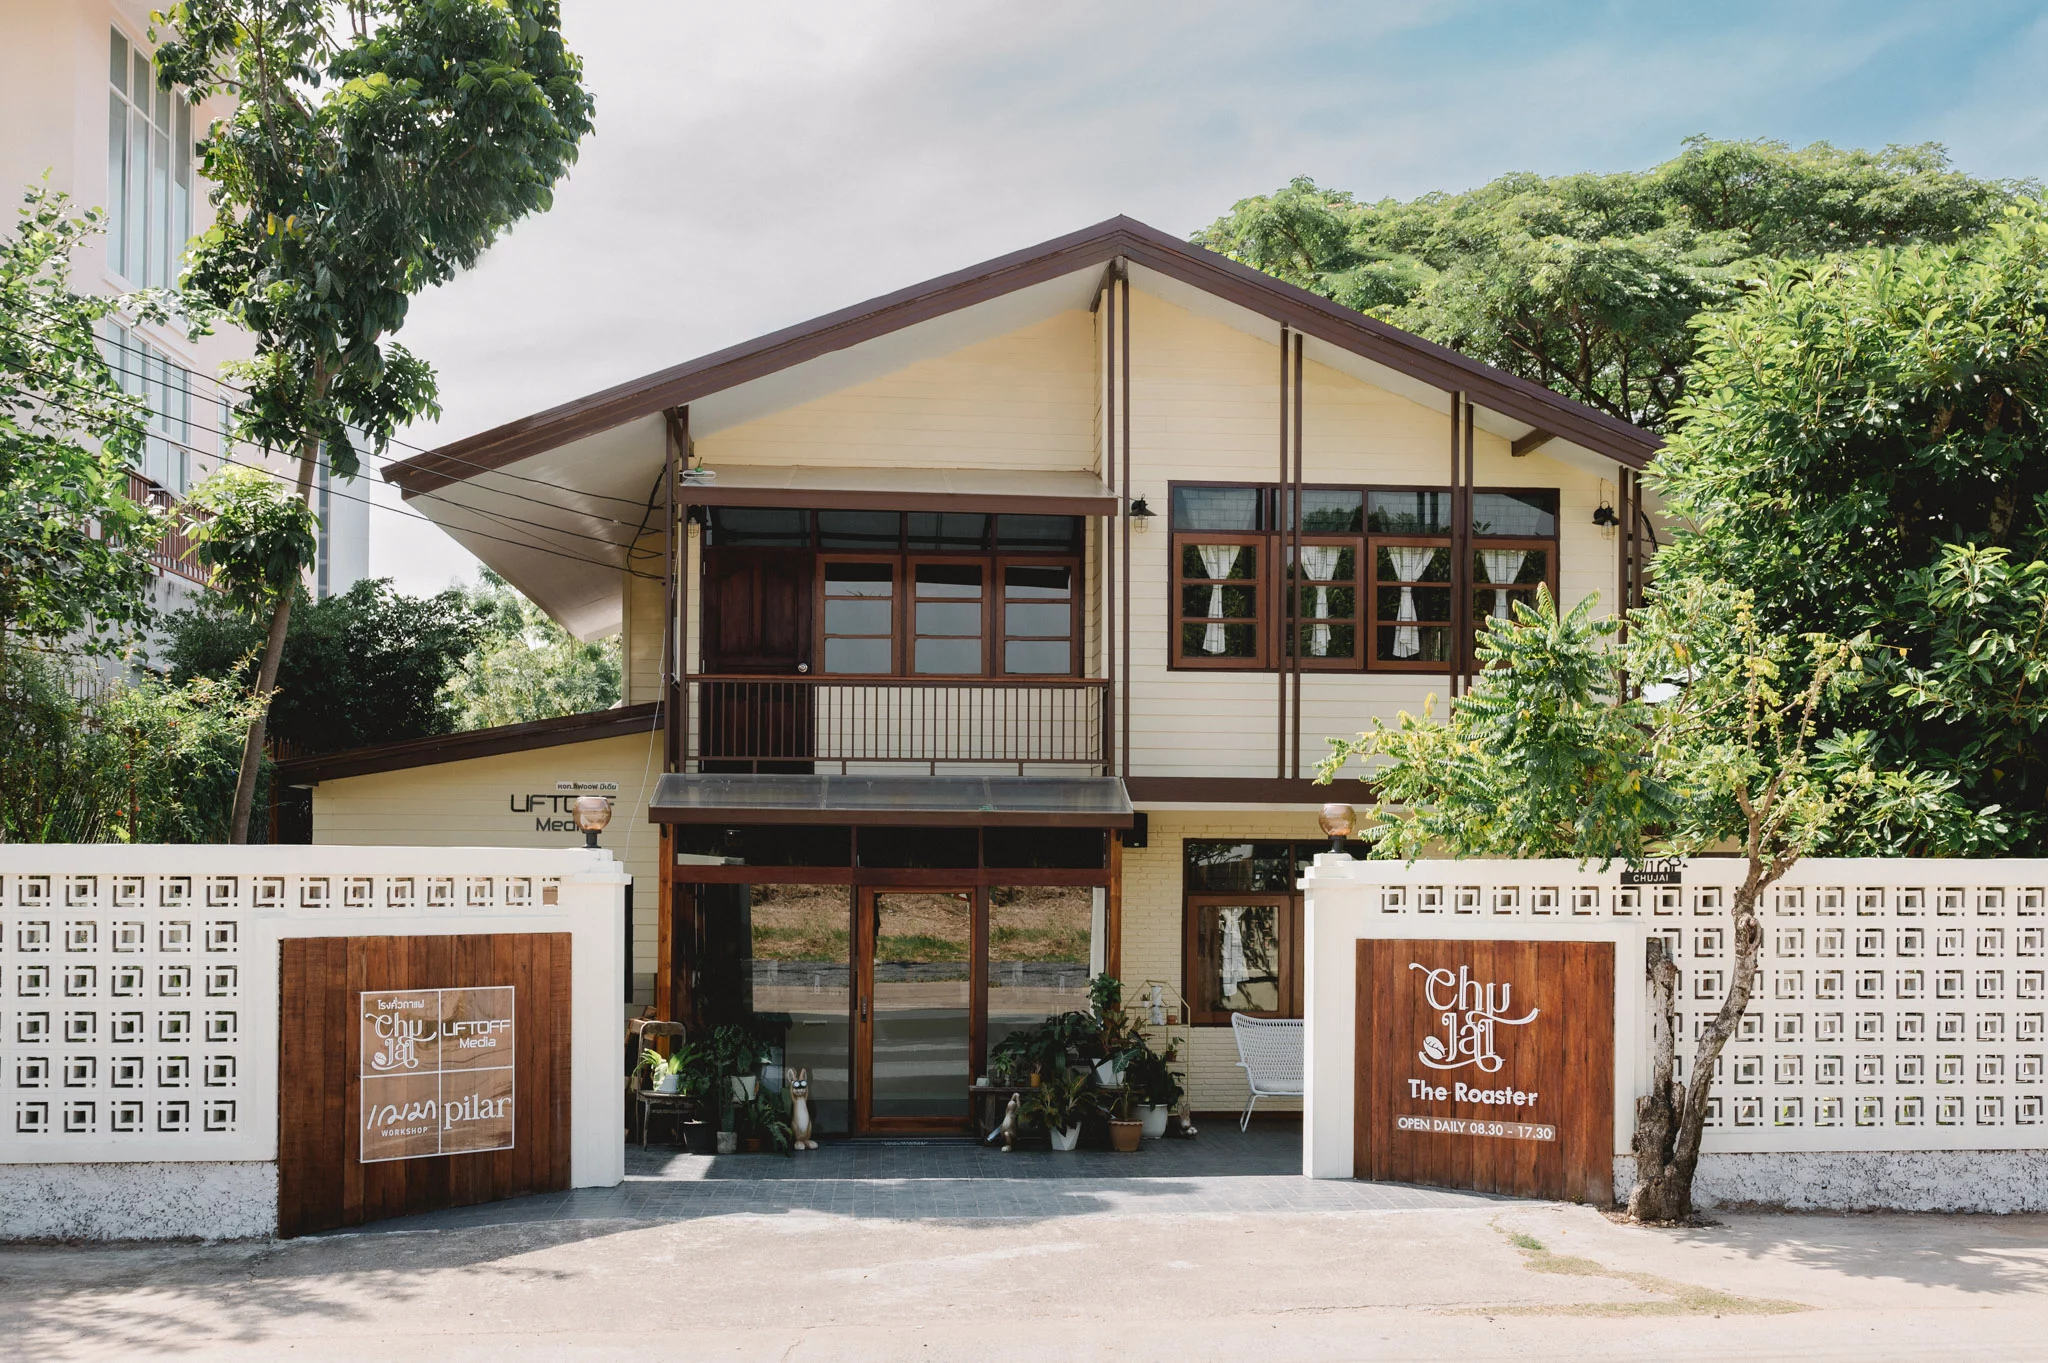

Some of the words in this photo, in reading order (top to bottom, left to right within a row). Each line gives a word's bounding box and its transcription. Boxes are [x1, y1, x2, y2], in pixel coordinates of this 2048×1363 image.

[1633, 874, 1669, 882] CHUJAI
[377, 996, 425, 1010] โรงคั่วกาแฟ
[1408, 962, 1541, 1025] Chu
[365, 1012, 437, 1042] Chu
[442, 1019, 511, 1036] LIFTOFF
[459, 1037, 496, 1048] Media
[1408, 1078, 1447, 1101] The
[1455, 1082, 1538, 1107] Roaster
[443, 1093, 512, 1130] pilar
[381, 1126, 429, 1137] WORKSHOP
[1397, 1117, 1430, 1131] OPEN
[1433, 1120, 1466, 1134] DAILY
[1469, 1122, 1504, 1136] 08.30
[1518, 1126, 1553, 1140] 17.30
